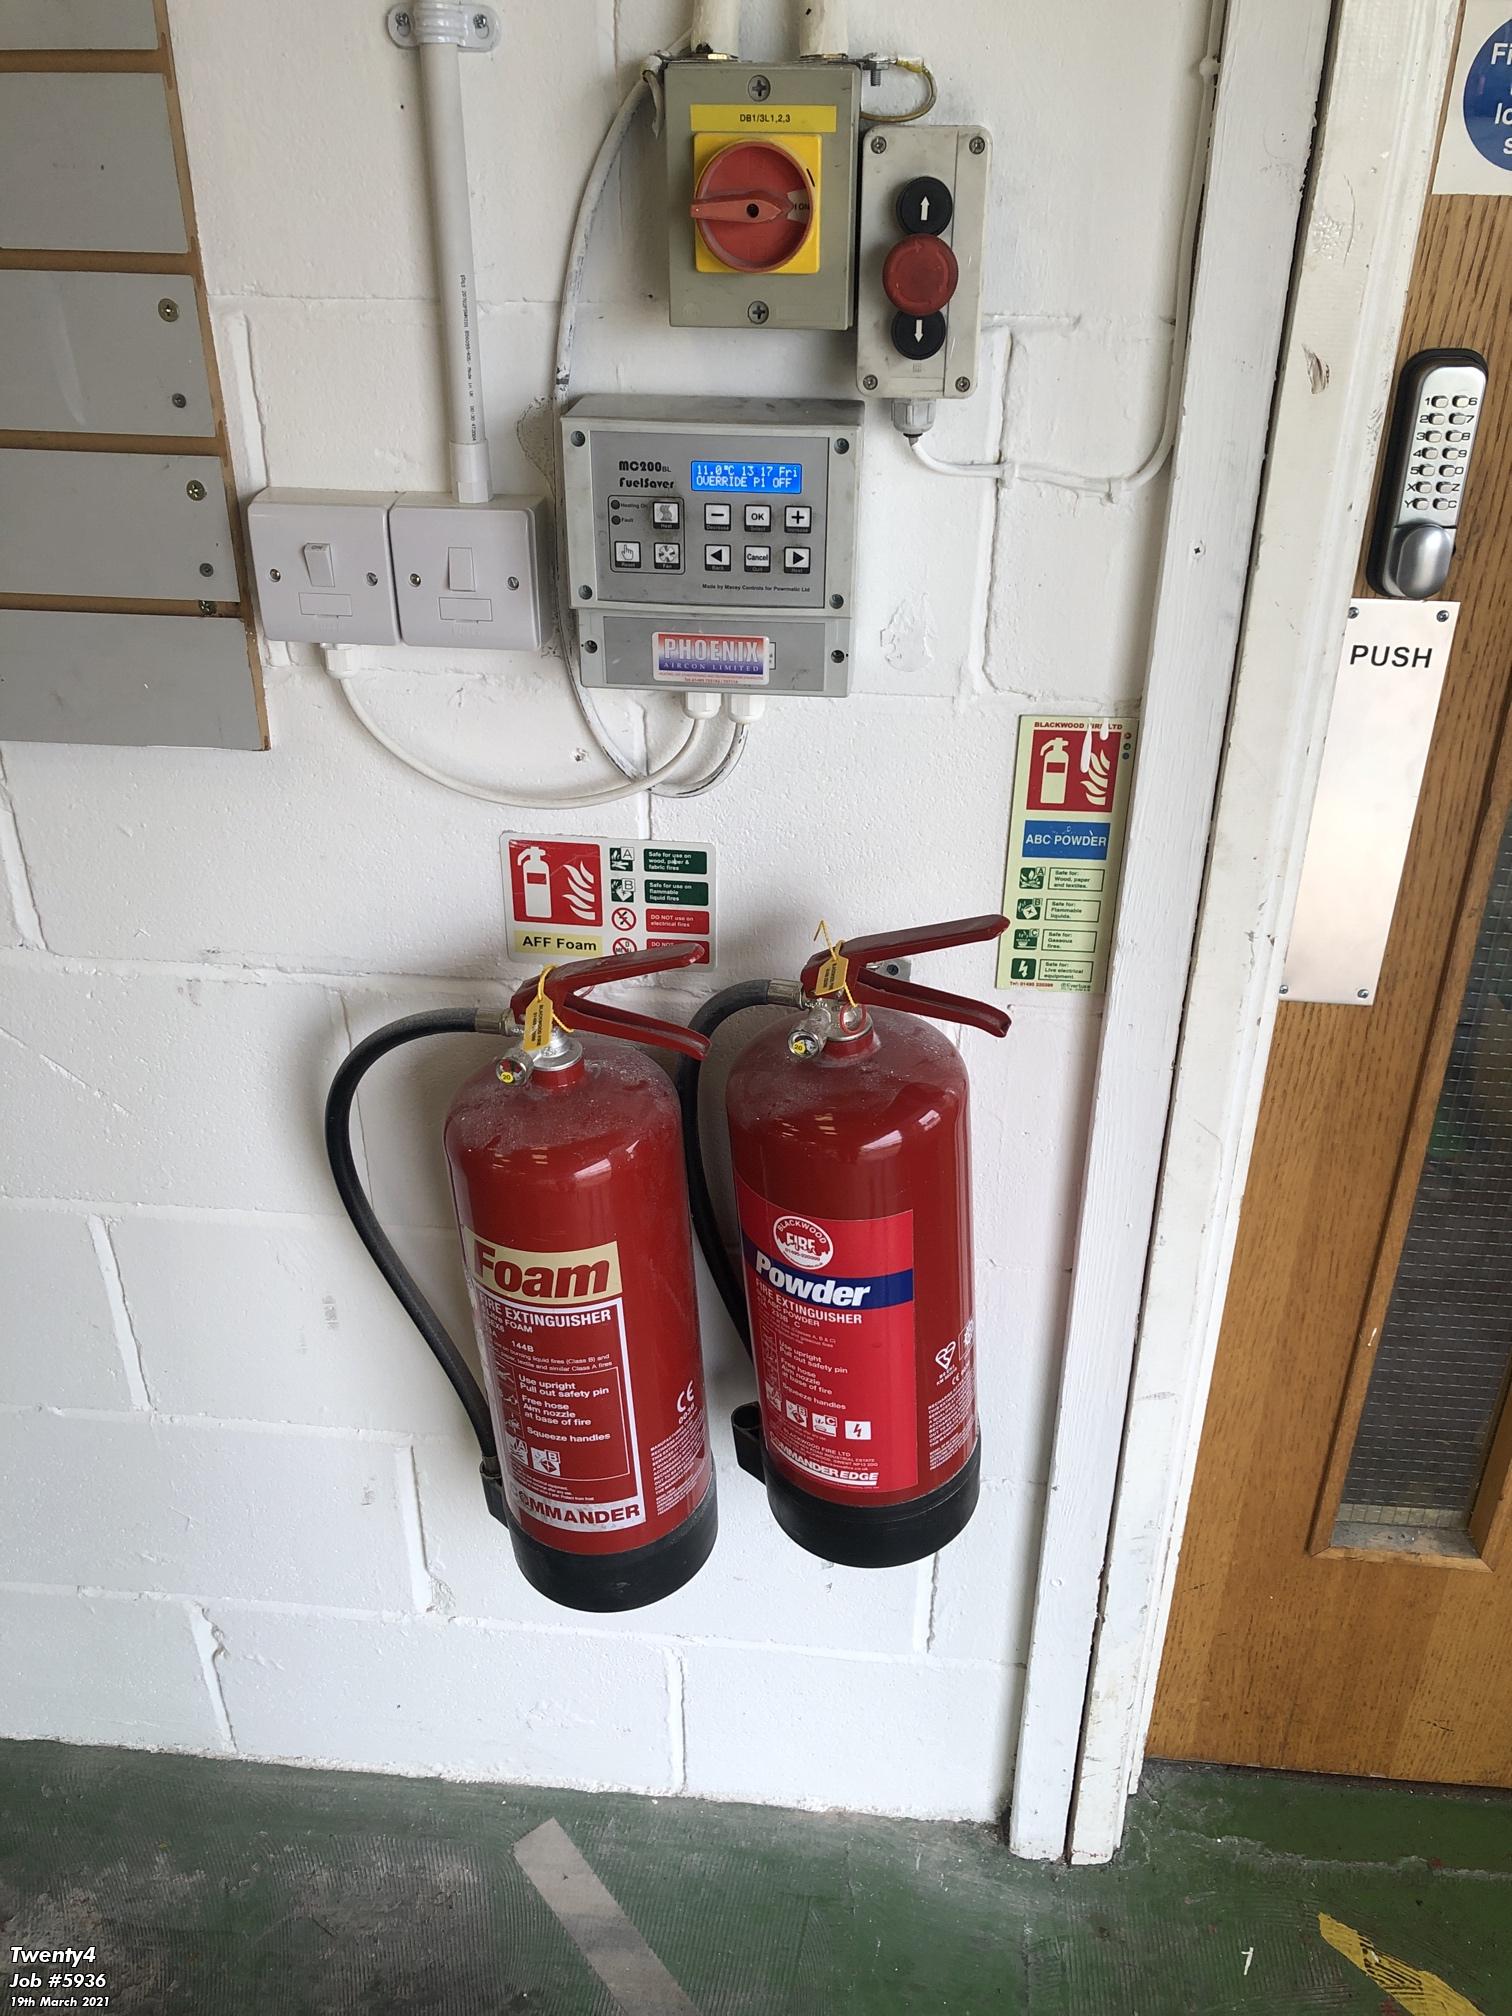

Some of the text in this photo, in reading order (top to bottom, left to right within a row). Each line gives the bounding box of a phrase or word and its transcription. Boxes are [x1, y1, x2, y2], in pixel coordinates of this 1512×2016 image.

[739, 114, 791, 123] DB1/3L1,2,3
[1468, 397, 1478, 405] 6
[1419, 415, 1429, 423] 2
[1466, 415, 1475, 423] 7
[1416, 432, 1426, 440] 3
[1461, 432, 1471, 440] 8
[761, 467, 773, 477] 17
[779, 468, 798, 478] Fri
[619, 477, 674, 489] FuelSaver
[696, 476, 748, 488] OVERRIDE
[772, 478, 792, 488] OFF
[1406, 483, 1416, 491] X
[1404, 500, 1413, 508] Y
[1448, 500, 1457, 508] C
[746, 553, 769, 561] Cancel
[664, 638, 758, 662] PHOENIX
[1349, 644, 1433, 668] PUSH
[1034, 721, 1085, 729] BLACKWOOD
[1025, 834, 1107, 847] ABC POWDER
[623, 848, 633, 859] A
[624, 880, 634, 890] B
[522, 935, 597, 952] AFF Foam
[777, 1220, 827, 1244] BLACKWOOD
[786, 1232, 816, 1251] FIRE
[474, 1239, 610, 1298] Foam
[756, 1251, 871, 1307] Powder
[755, 1278, 774, 1299] FIRE
[775, 1294, 862, 1324] EXTINGUISHER
[481, 1295, 502, 1315] FIRE
[505, 1307, 611, 1328] EXTINGUISHER
[783, 1308, 820, 1327] POWDER
[505, 1319, 533, 1334] FOAM
[512, 1340, 534, 1353] 144B
[597, 1353, 610, 1362] and
[794, 1349, 822, 1363] upright
[536, 1361, 548, 1369] and
[549, 1363, 570, 1372] similar
[797, 1366, 816, 1379] hose
[807, 1361, 833, 1373] safety
[518, 1374, 577, 1391] Use upright
[789, 1375, 807, 1388] base
[818, 1386, 833, 1395] fire
[795, 1373, 820, 1386] nozzle
[520, 1382, 610, 1399] Pull out safety pin
[782, 1382, 847, 1410] Squeeze handles
[521, 1394, 570, 1410] Free hose
[523, 1403, 576, 1418] Aim nozzle
[524, 1412, 592, 1426] at base of fire
[827, 1417, 836, 1426] C
[526, 1426, 611, 1443] Squeeze handles
[547, 1451, 559, 1462] B
[821, 1446, 837, 1455] FIRE
